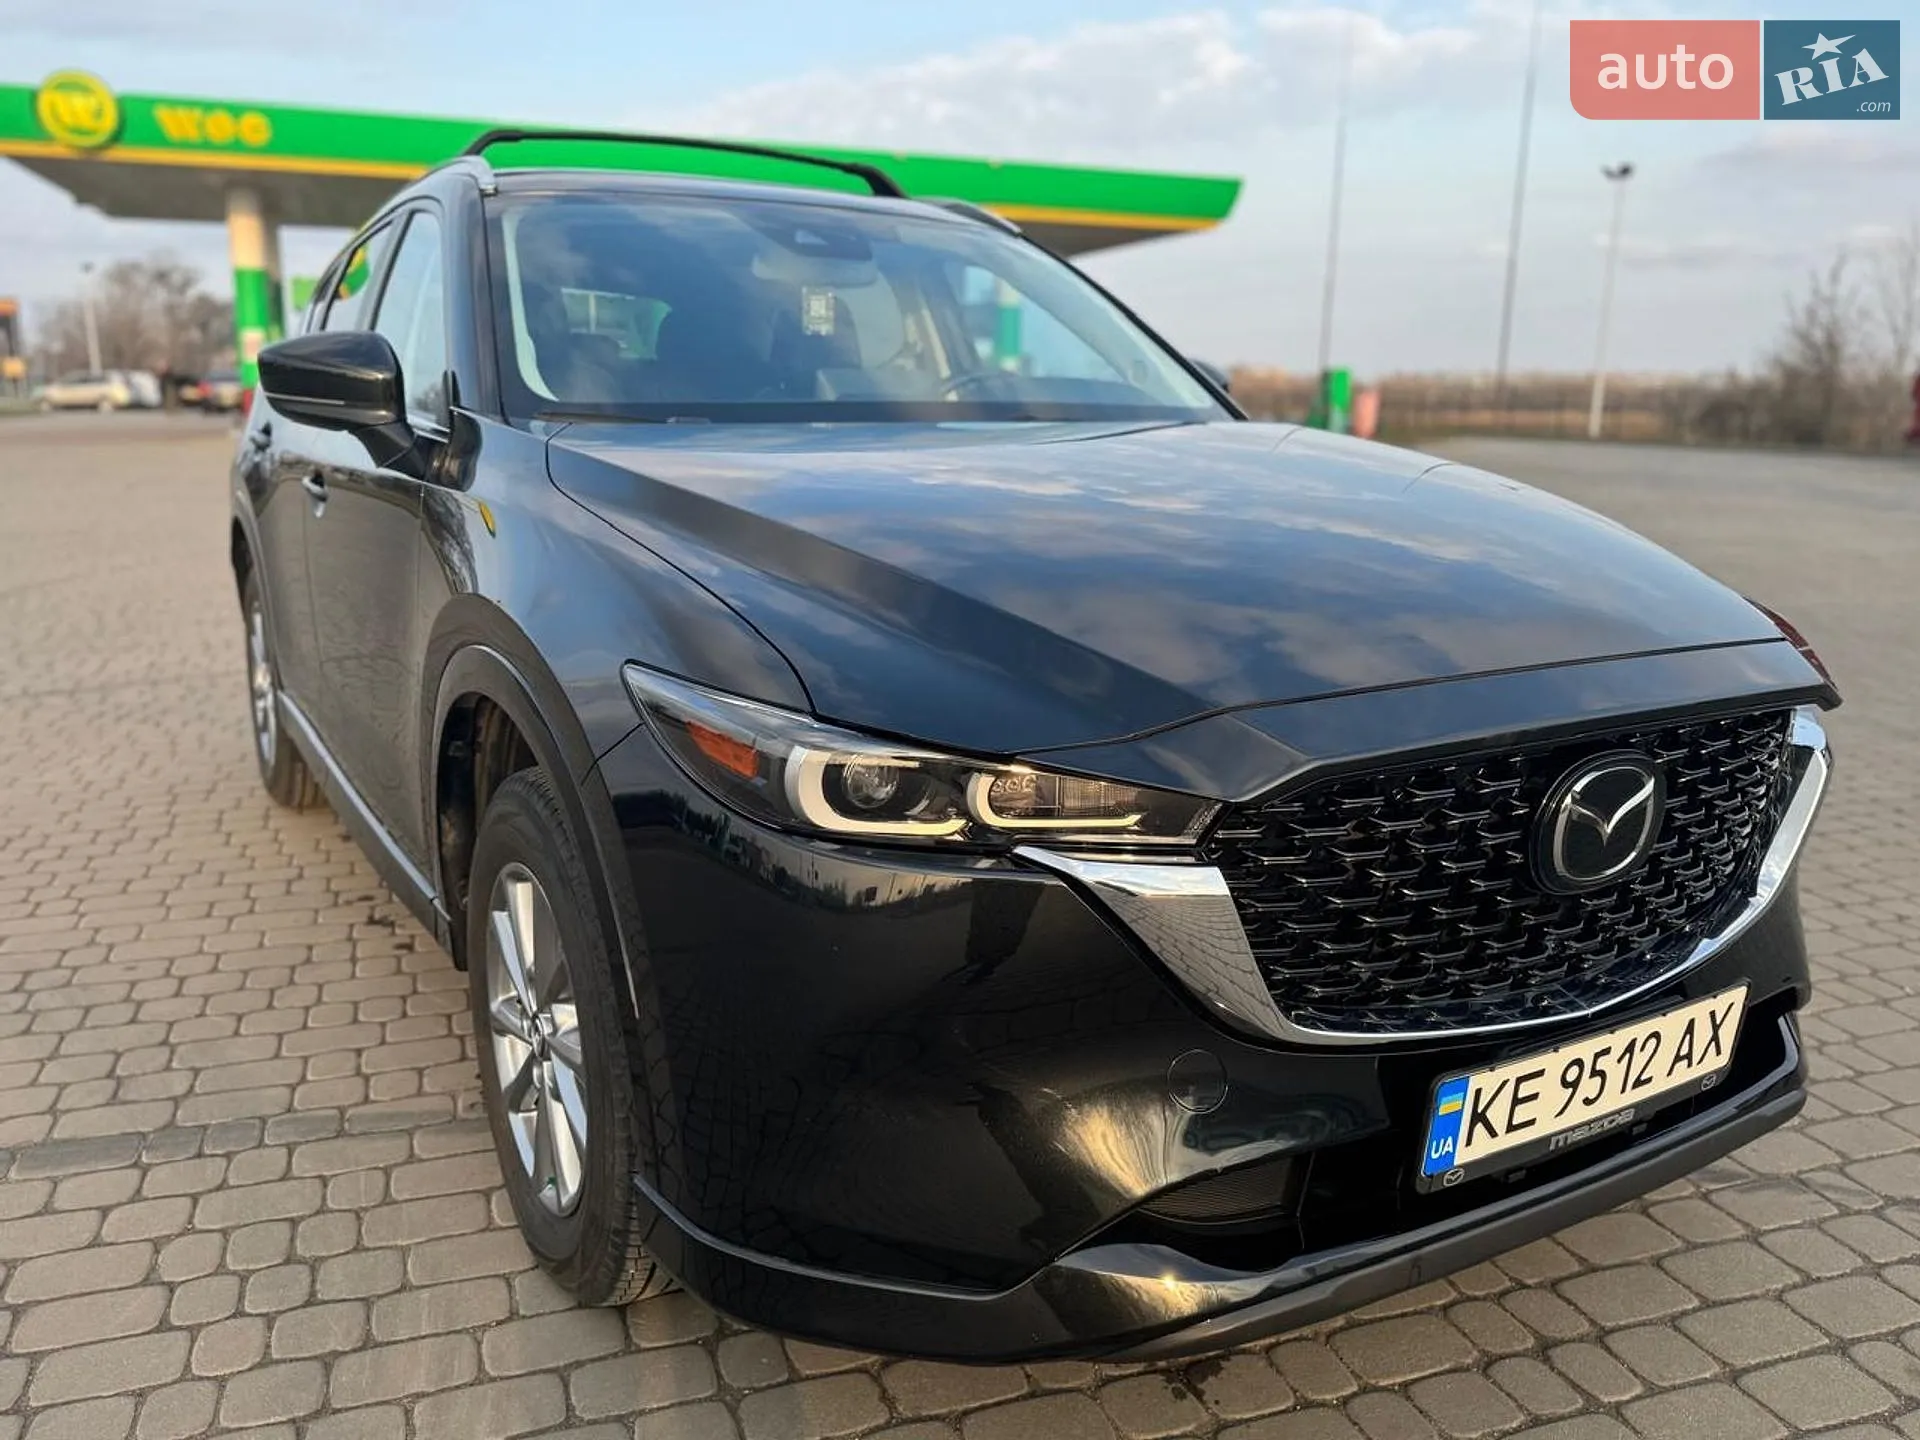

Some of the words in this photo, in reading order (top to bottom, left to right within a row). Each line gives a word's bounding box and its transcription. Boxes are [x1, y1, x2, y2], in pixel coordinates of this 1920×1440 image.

[1464, 1069, 1545, 1147] KE
[1554, 1030, 1662, 1118] 9512
[1667, 1001, 1735, 1078] AX
[1431, 1136, 1453, 1160] UA
